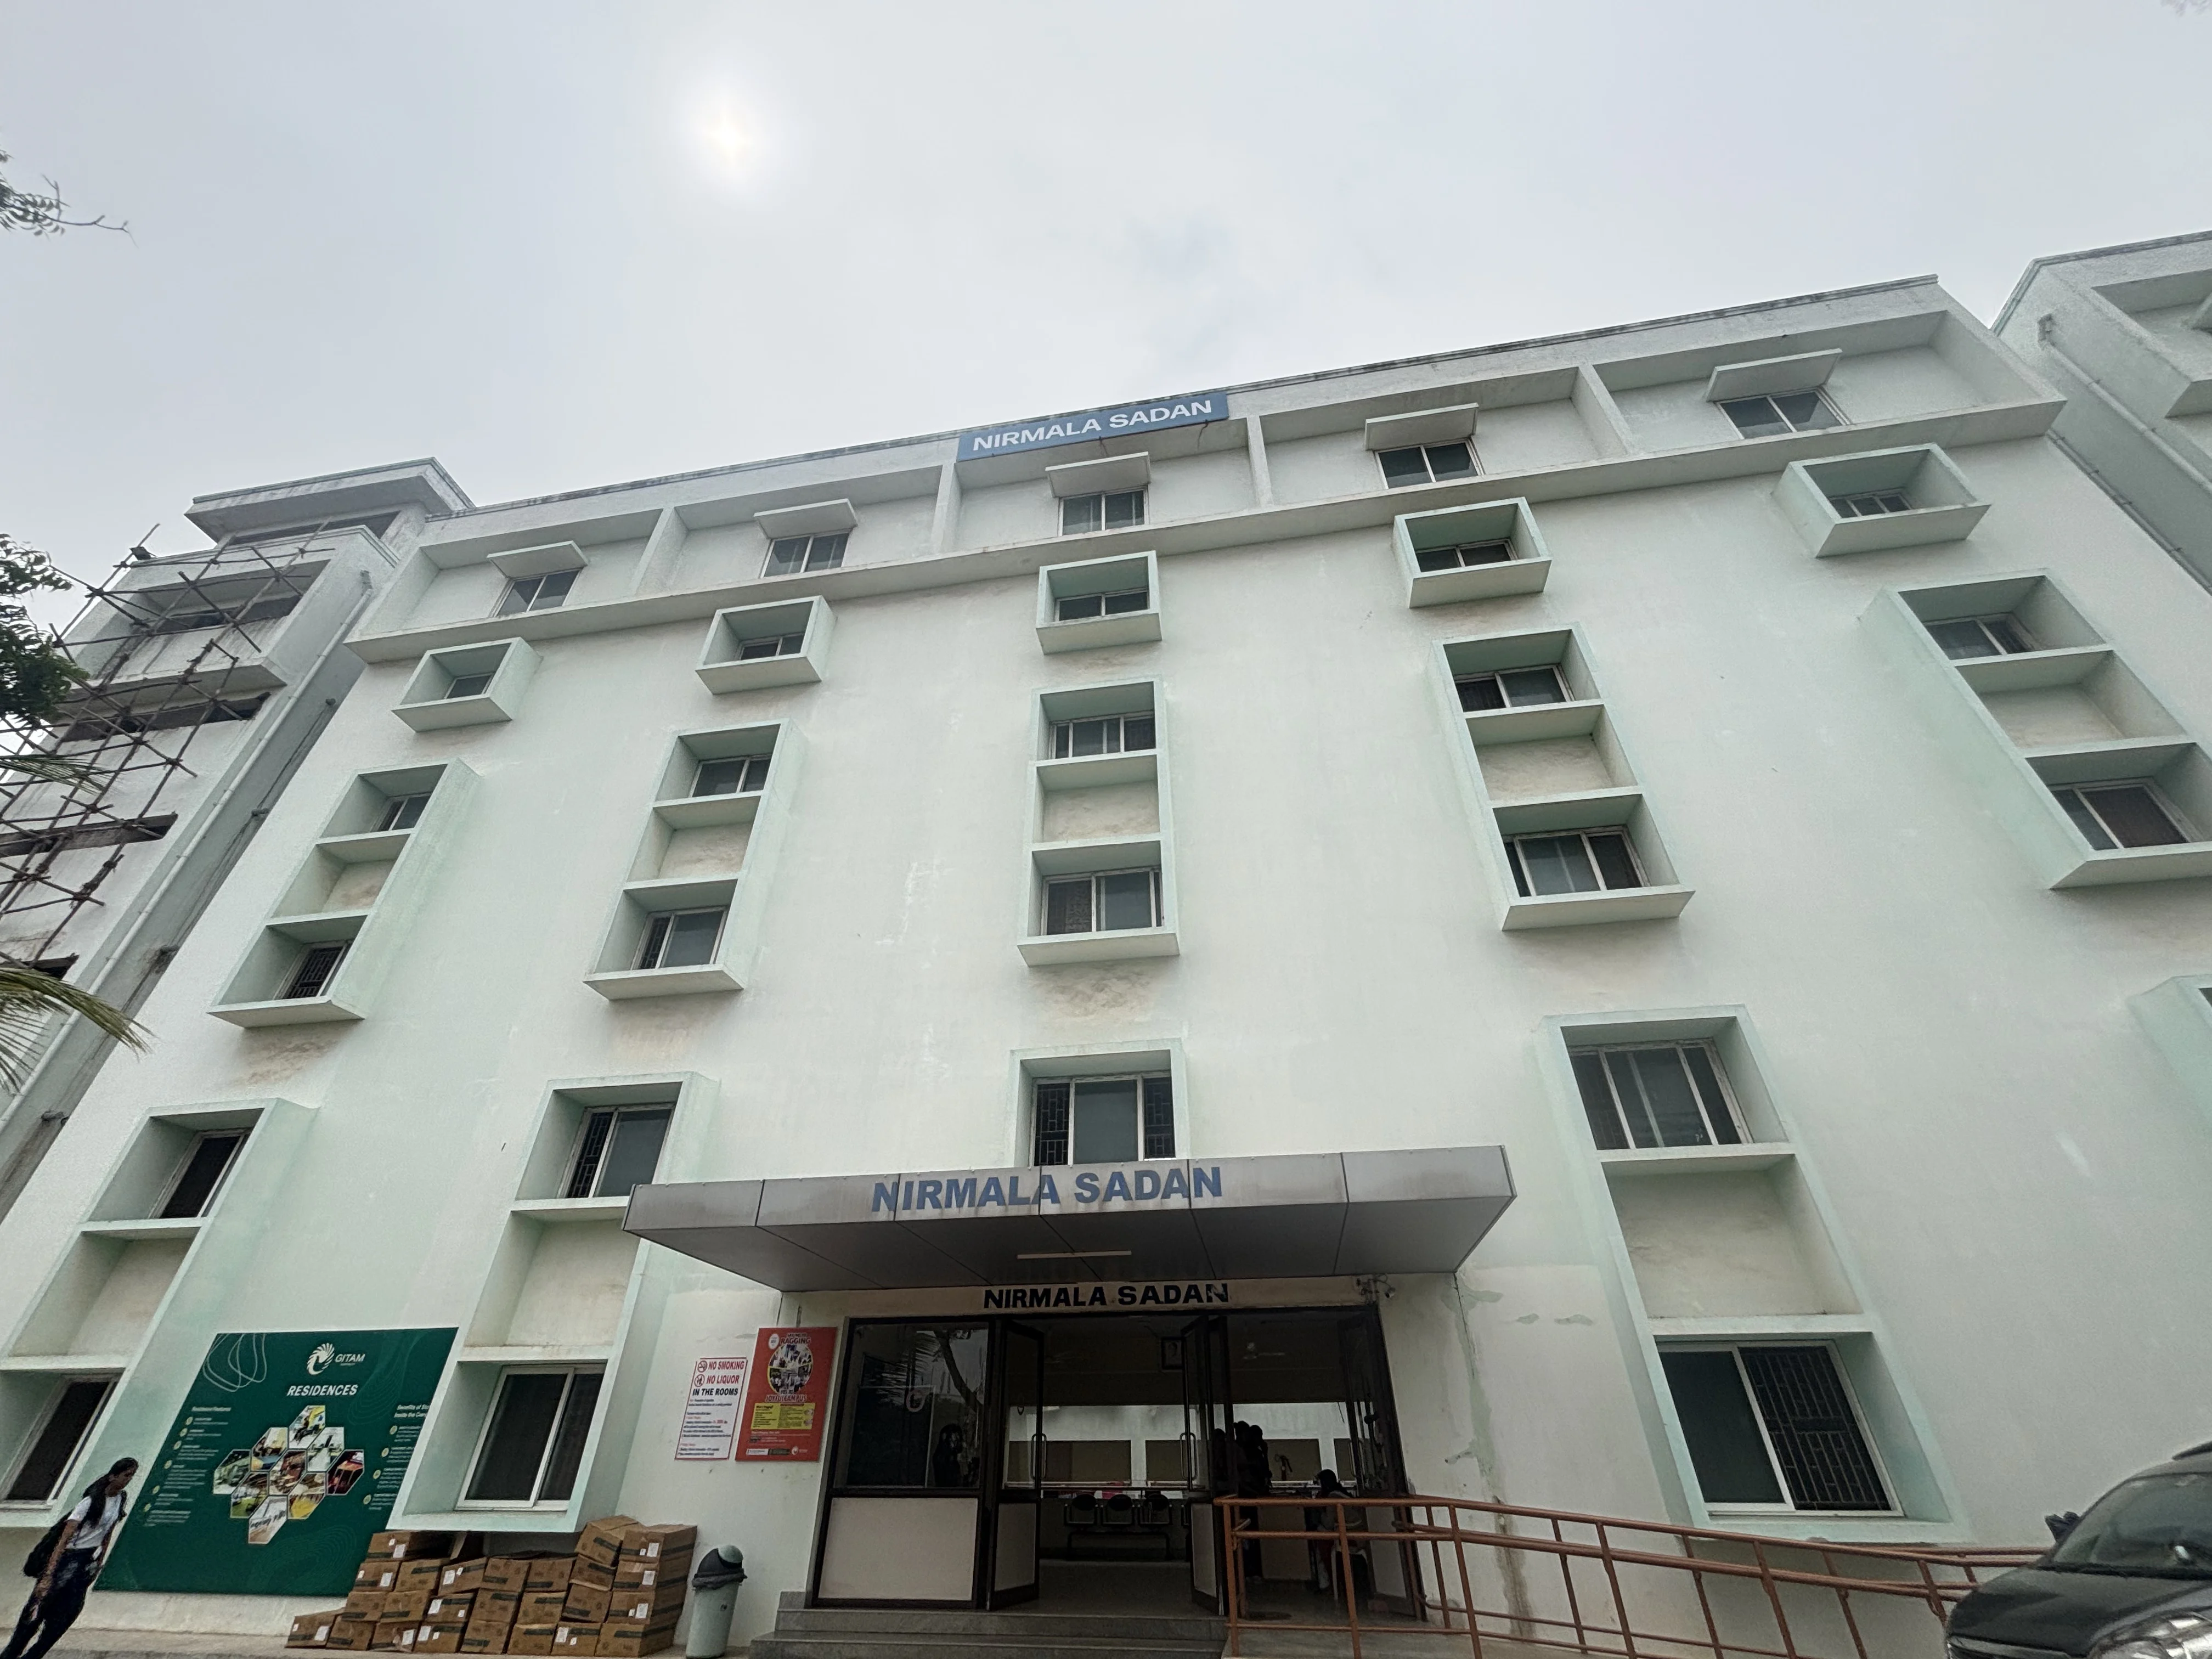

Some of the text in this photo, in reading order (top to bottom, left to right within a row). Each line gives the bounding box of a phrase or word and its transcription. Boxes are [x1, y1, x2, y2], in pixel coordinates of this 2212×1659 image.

[973, 400, 1212, 452] NIRMALA SADAN
[871, 1166, 1223, 1212] NIRMALA SADAN
[984, 1283, 1229, 1310] NIRMALA SADAN
[334, 1353, 366, 1363] GITAM
[708, 1361, 744, 1370] NO SMOKING
[706, 1375, 740, 1384] NO LIQUOR
[286, 1384, 358, 1396] RESIDENCES
